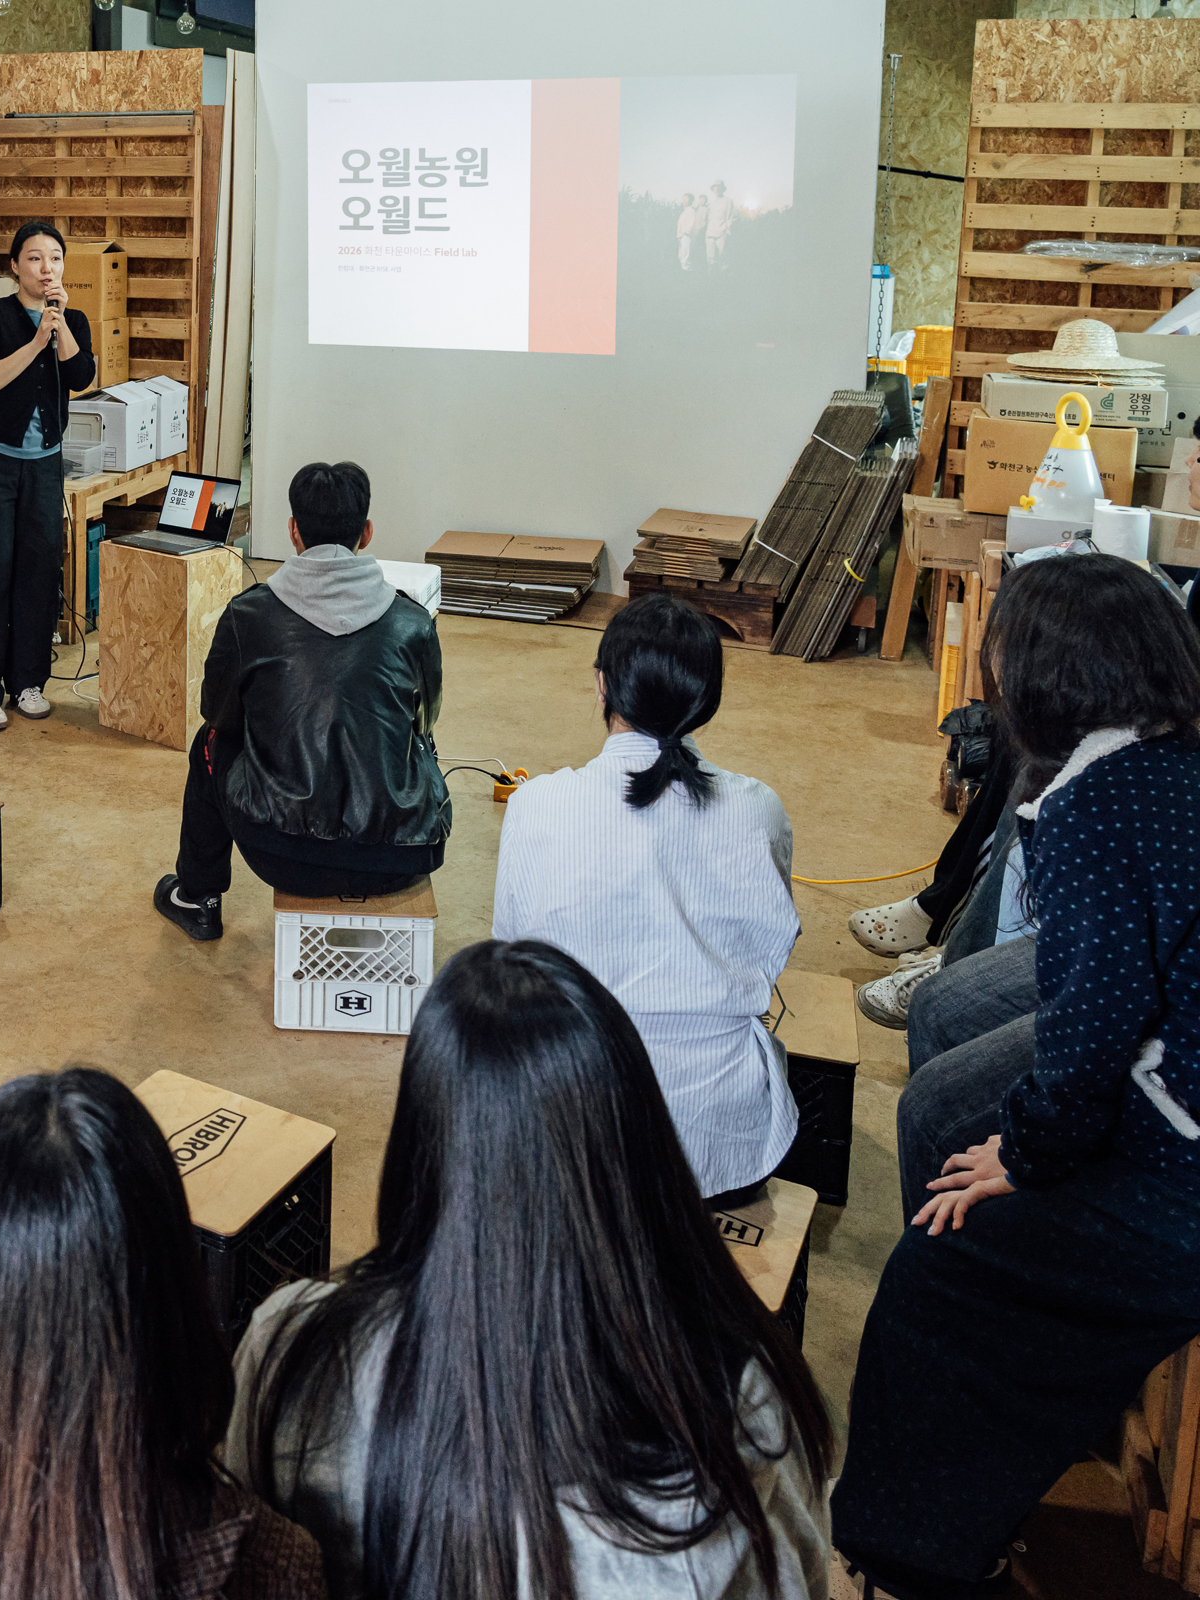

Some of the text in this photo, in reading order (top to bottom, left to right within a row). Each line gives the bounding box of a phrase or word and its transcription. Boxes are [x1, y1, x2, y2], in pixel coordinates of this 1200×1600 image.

[339, 147, 489, 188] 오월농원
[339, 195, 451, 235] 오월드
[337, 246, 478, 257] 2026 화천 타운마이스 Field lab
[63, 282, 93, 290] 가공지원센터
[1129, 393, 1152, 405] 강원
[1128, 404, 1152, 416] 우유
[999, 462, 1024, 473] 화천군
[171, 487, 195, 499] 오월농원
[169, 496, 187, 506] 오월드
[340, 996, 367, 1011] H
